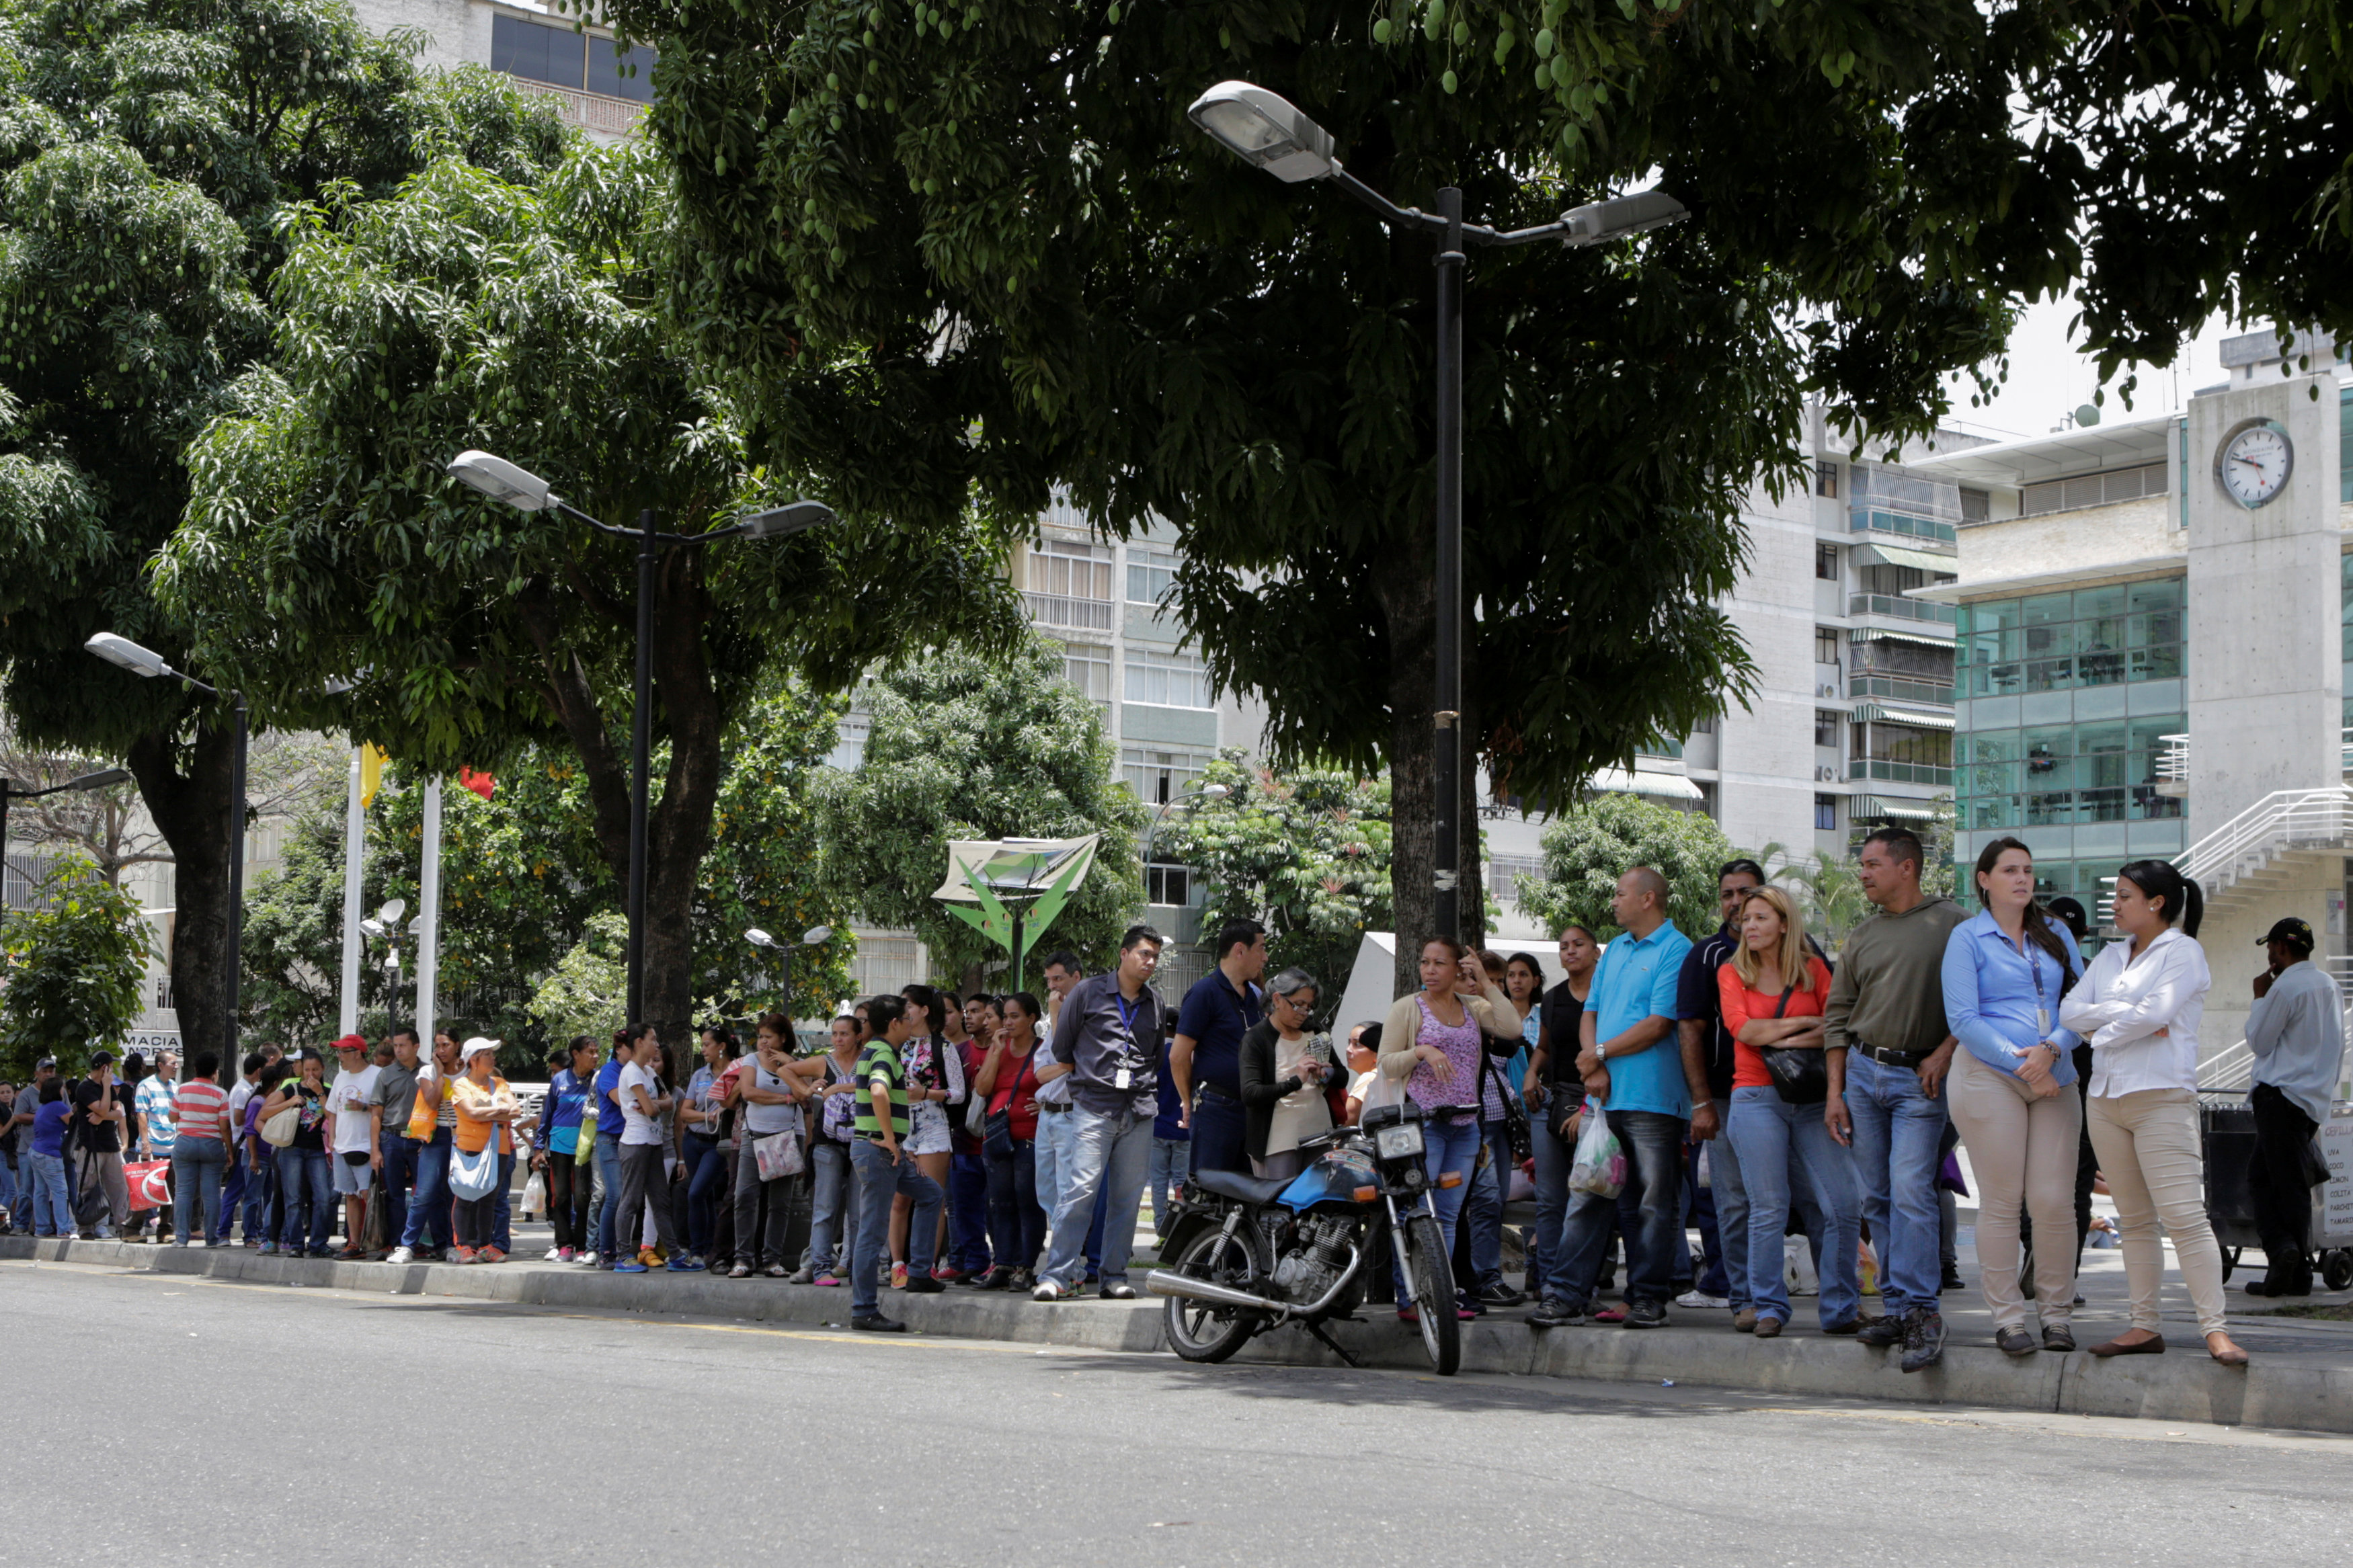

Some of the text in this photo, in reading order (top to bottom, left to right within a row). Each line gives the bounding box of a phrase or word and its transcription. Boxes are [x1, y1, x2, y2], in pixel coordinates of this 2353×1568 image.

[2243, 445, 2274, 454] MONDAINE
[118, 1036, 178, 1046] MACIA
[1343, 1163, 1364, 1173] HONDA
[2329, 1162, 2344, 1170] COCO
[2329, 1175, 2349, 1184] LIMON
[2330, 1190, 2351, 1198] COLITA
